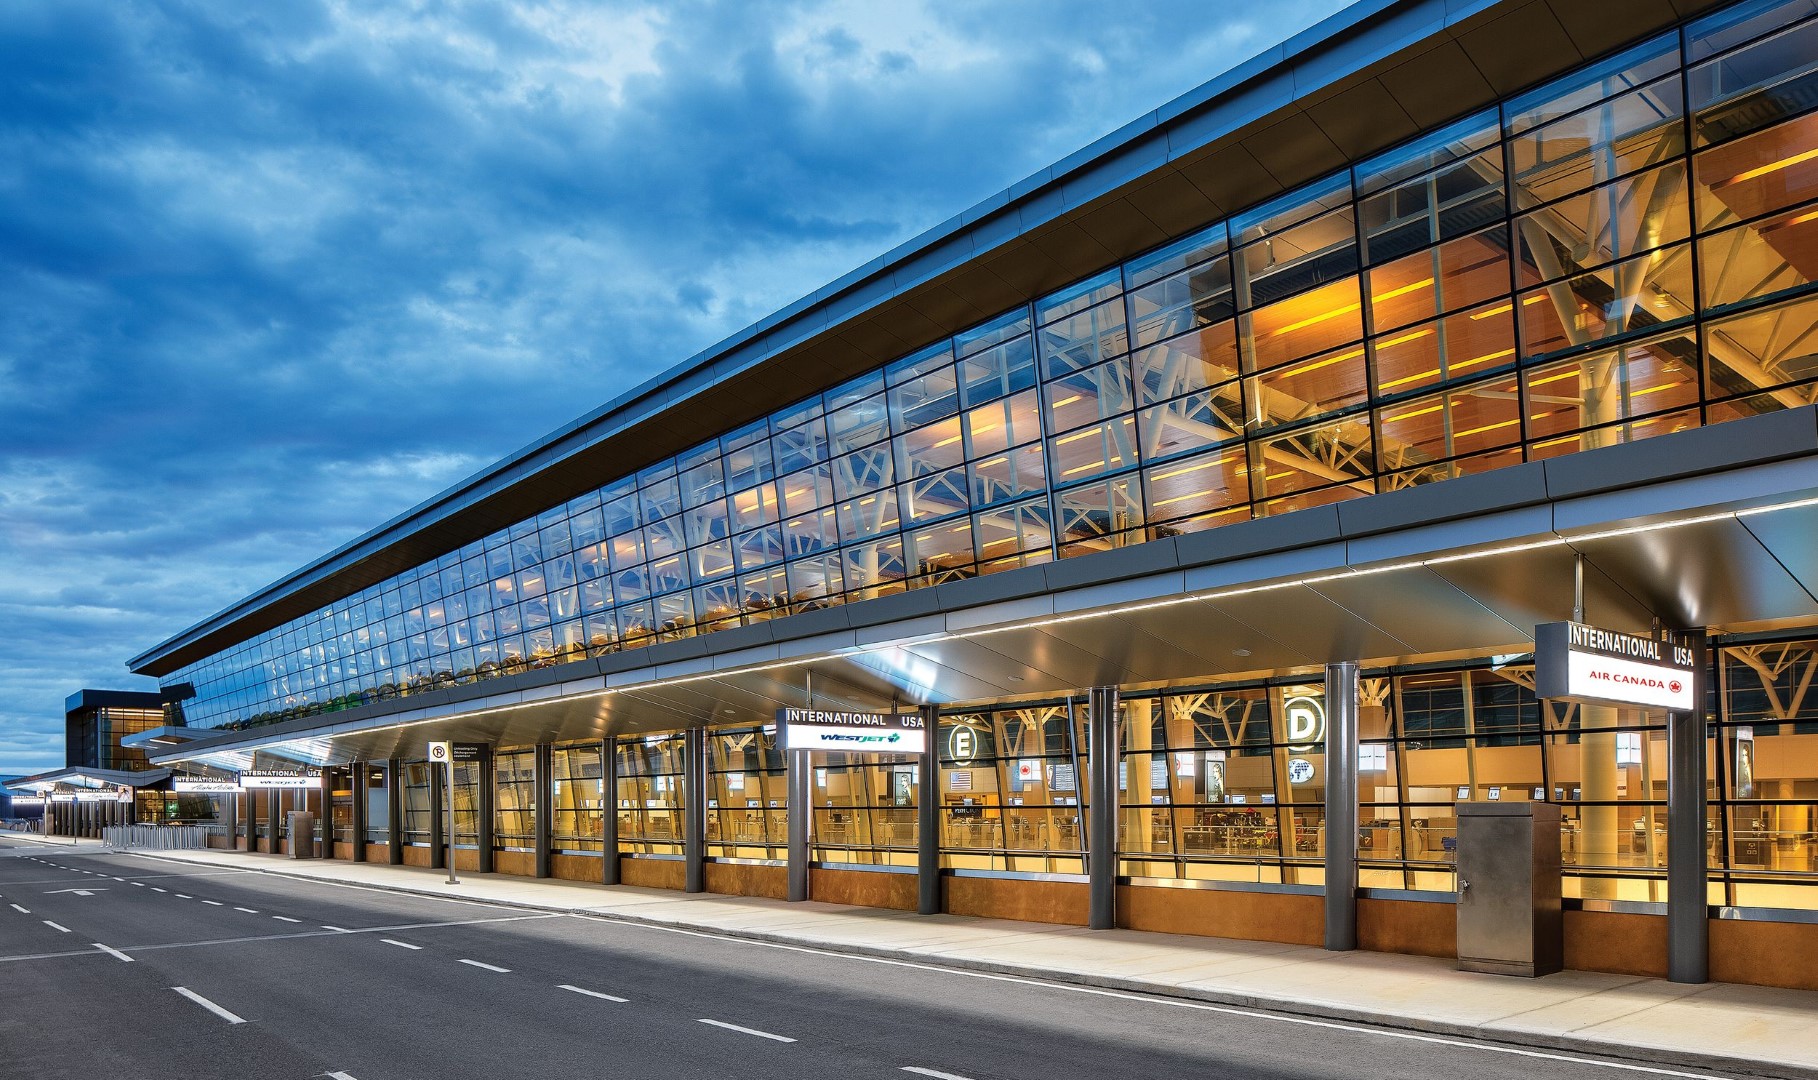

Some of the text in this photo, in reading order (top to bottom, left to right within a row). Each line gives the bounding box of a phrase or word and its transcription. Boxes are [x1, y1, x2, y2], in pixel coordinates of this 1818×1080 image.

[1568, 625, 1694, 667] INTERNATIONAL USA
[1589, 671, 1665, 689] AIR CANADA
[787, 710, 924, 728] INTERNATIONAL USA
[1290, 708, 1316, 740] D
[956, 732, 970, 757] E
